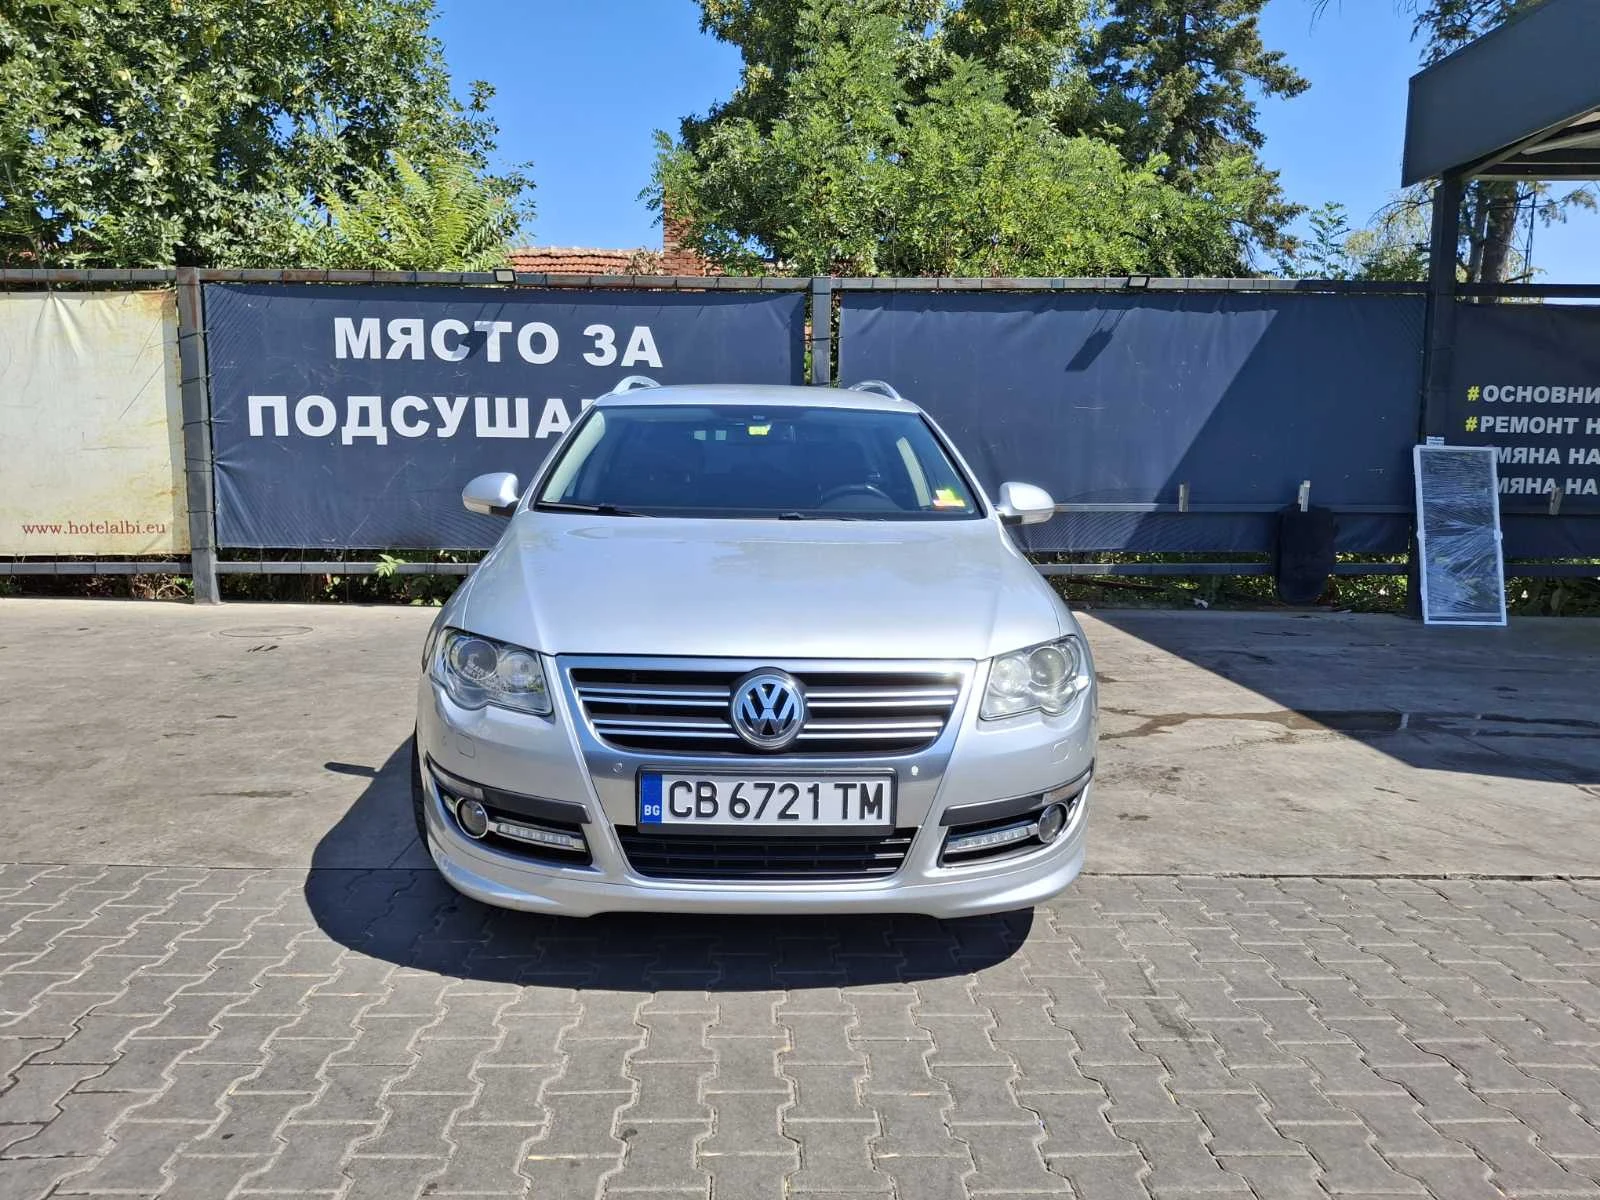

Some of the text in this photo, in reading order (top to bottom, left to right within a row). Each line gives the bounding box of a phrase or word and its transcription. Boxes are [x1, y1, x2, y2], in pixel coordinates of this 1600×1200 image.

[334, 317, 664, 368] МЯСТО ЗА
[1466, 384, 1600, 404] #ОСНОВНИ
[248, 394, 595, 446] ПОДСУША
[1465, 415, 1579, 434] #РЕМОНТ
[1496, 446, 1600, 465] МЯНА НА
[1498, 477, 1598, 496] МЯНА НА
[22, 520, 166, 535] www.hotelalbi.eu
[669, 780, 883, 820] CB 6721 TM
[644, 804, 661, 816] BG
